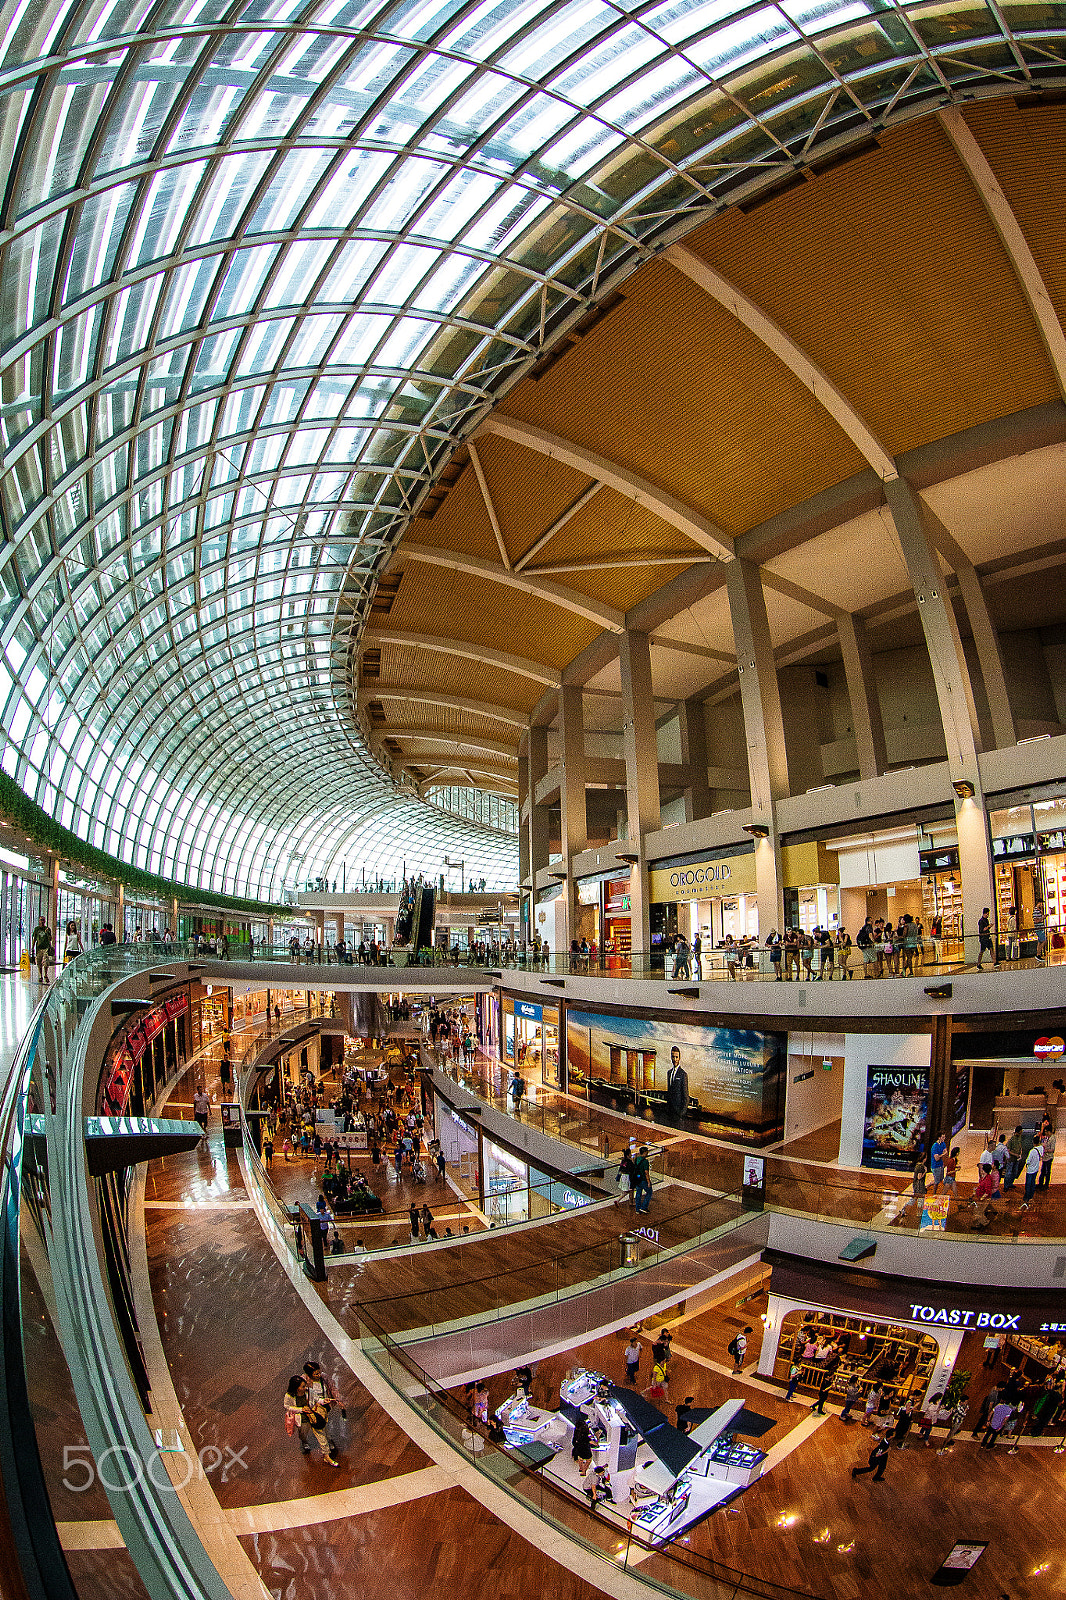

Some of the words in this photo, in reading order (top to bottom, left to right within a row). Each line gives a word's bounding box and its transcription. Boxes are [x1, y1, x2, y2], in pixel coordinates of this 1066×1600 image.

[670, 864, 732, 887] OROGOLD
[872, 1072, 921, 1090] SHAOLIN
[910, 1304, 975, 1326] TOAST
[976, 1312, 1021, 1331] BOX
